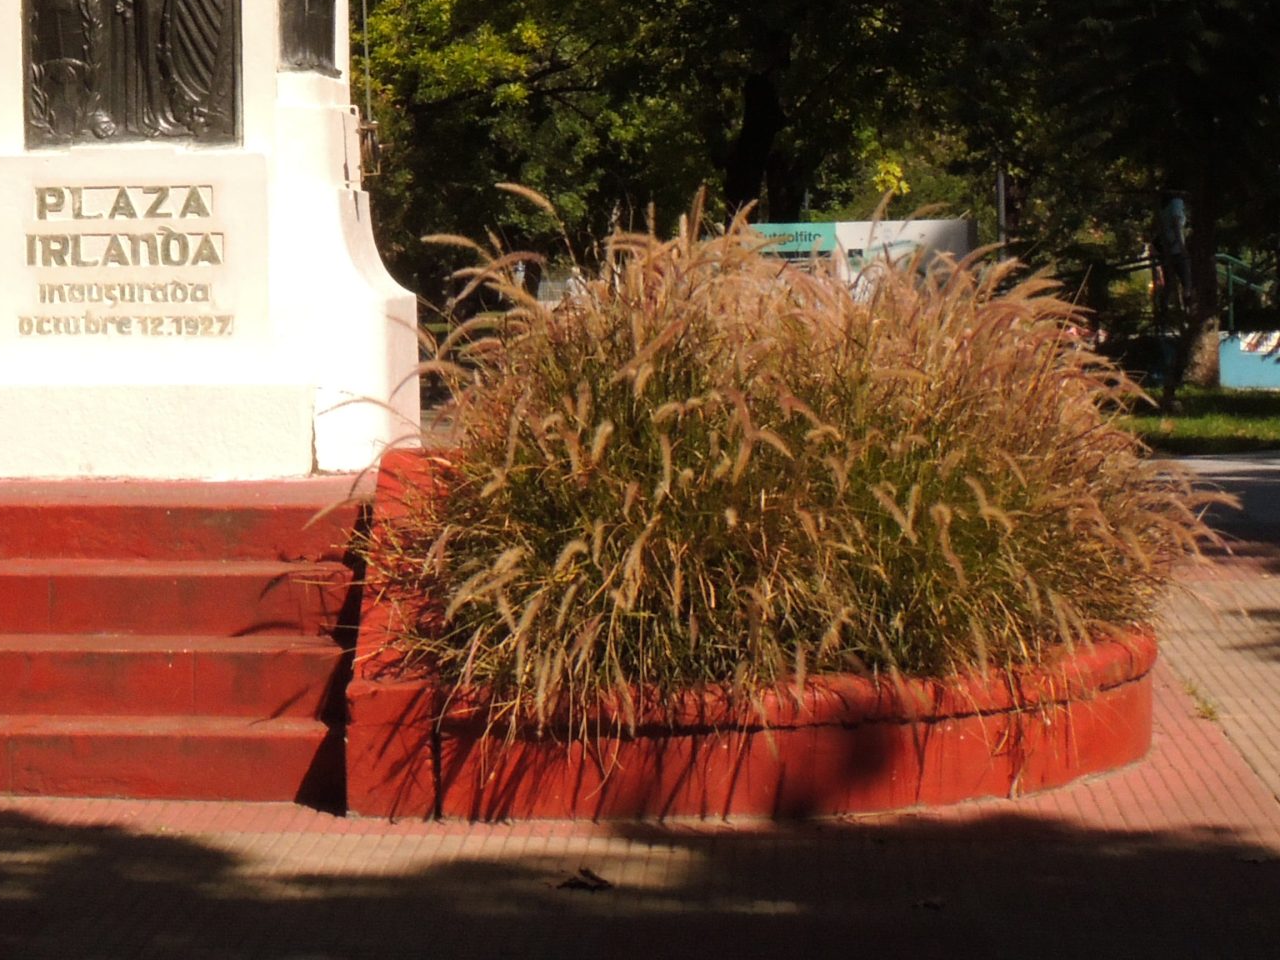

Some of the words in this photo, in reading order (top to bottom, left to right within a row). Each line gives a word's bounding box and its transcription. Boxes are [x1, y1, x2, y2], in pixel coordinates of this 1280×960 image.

[35, 186, 211, 220] PLAZA
[25, 226, 223, 267] IRLANDA
[38, 281, 210, 308] inaugurada
[18, 311, 132, 336] octubre
